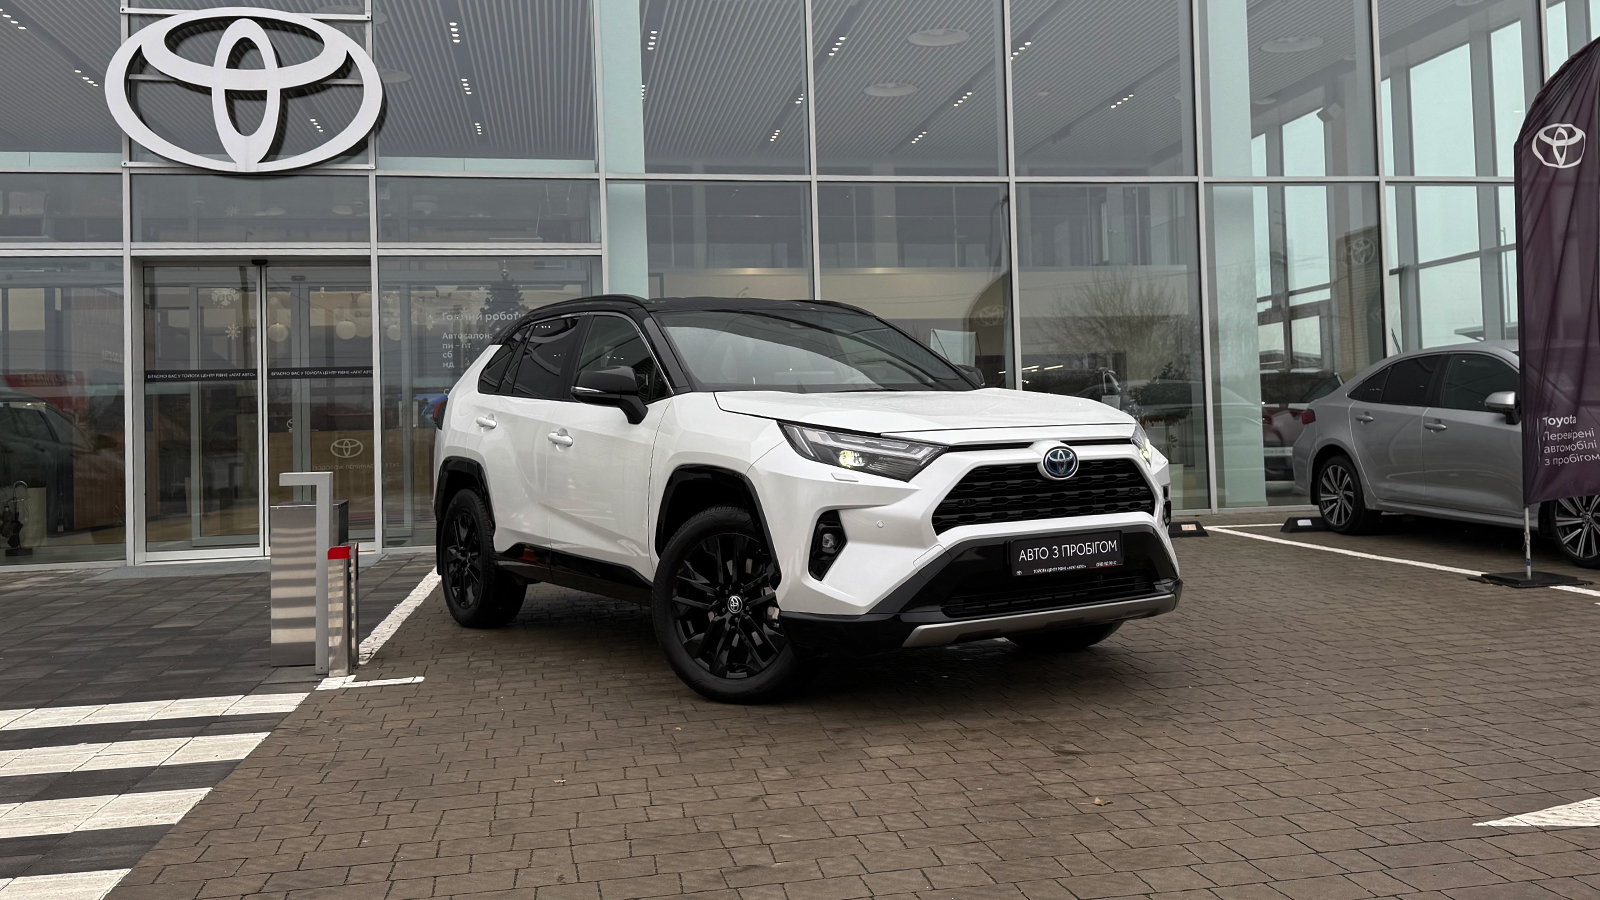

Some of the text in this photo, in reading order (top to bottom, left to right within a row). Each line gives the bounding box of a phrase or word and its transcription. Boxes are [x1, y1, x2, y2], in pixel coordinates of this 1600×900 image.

[442, 312, 483, 322] Години
[442, 332, 493, 340] Автосалон:
[442, 350, 453, 358] сб
[442, 361, 455, 369] нд
[1542, 415, 1577, 428] Toyota
[1542, 428, 1595, 442] Перевірені
[1543, 440, 1598, 454] автомобілі
[1544, 458, 1551, 466] з
[1018, 546, 1049, 562] АВТО
[1061, 540, 1118, 558] ПРОБІГОМ
